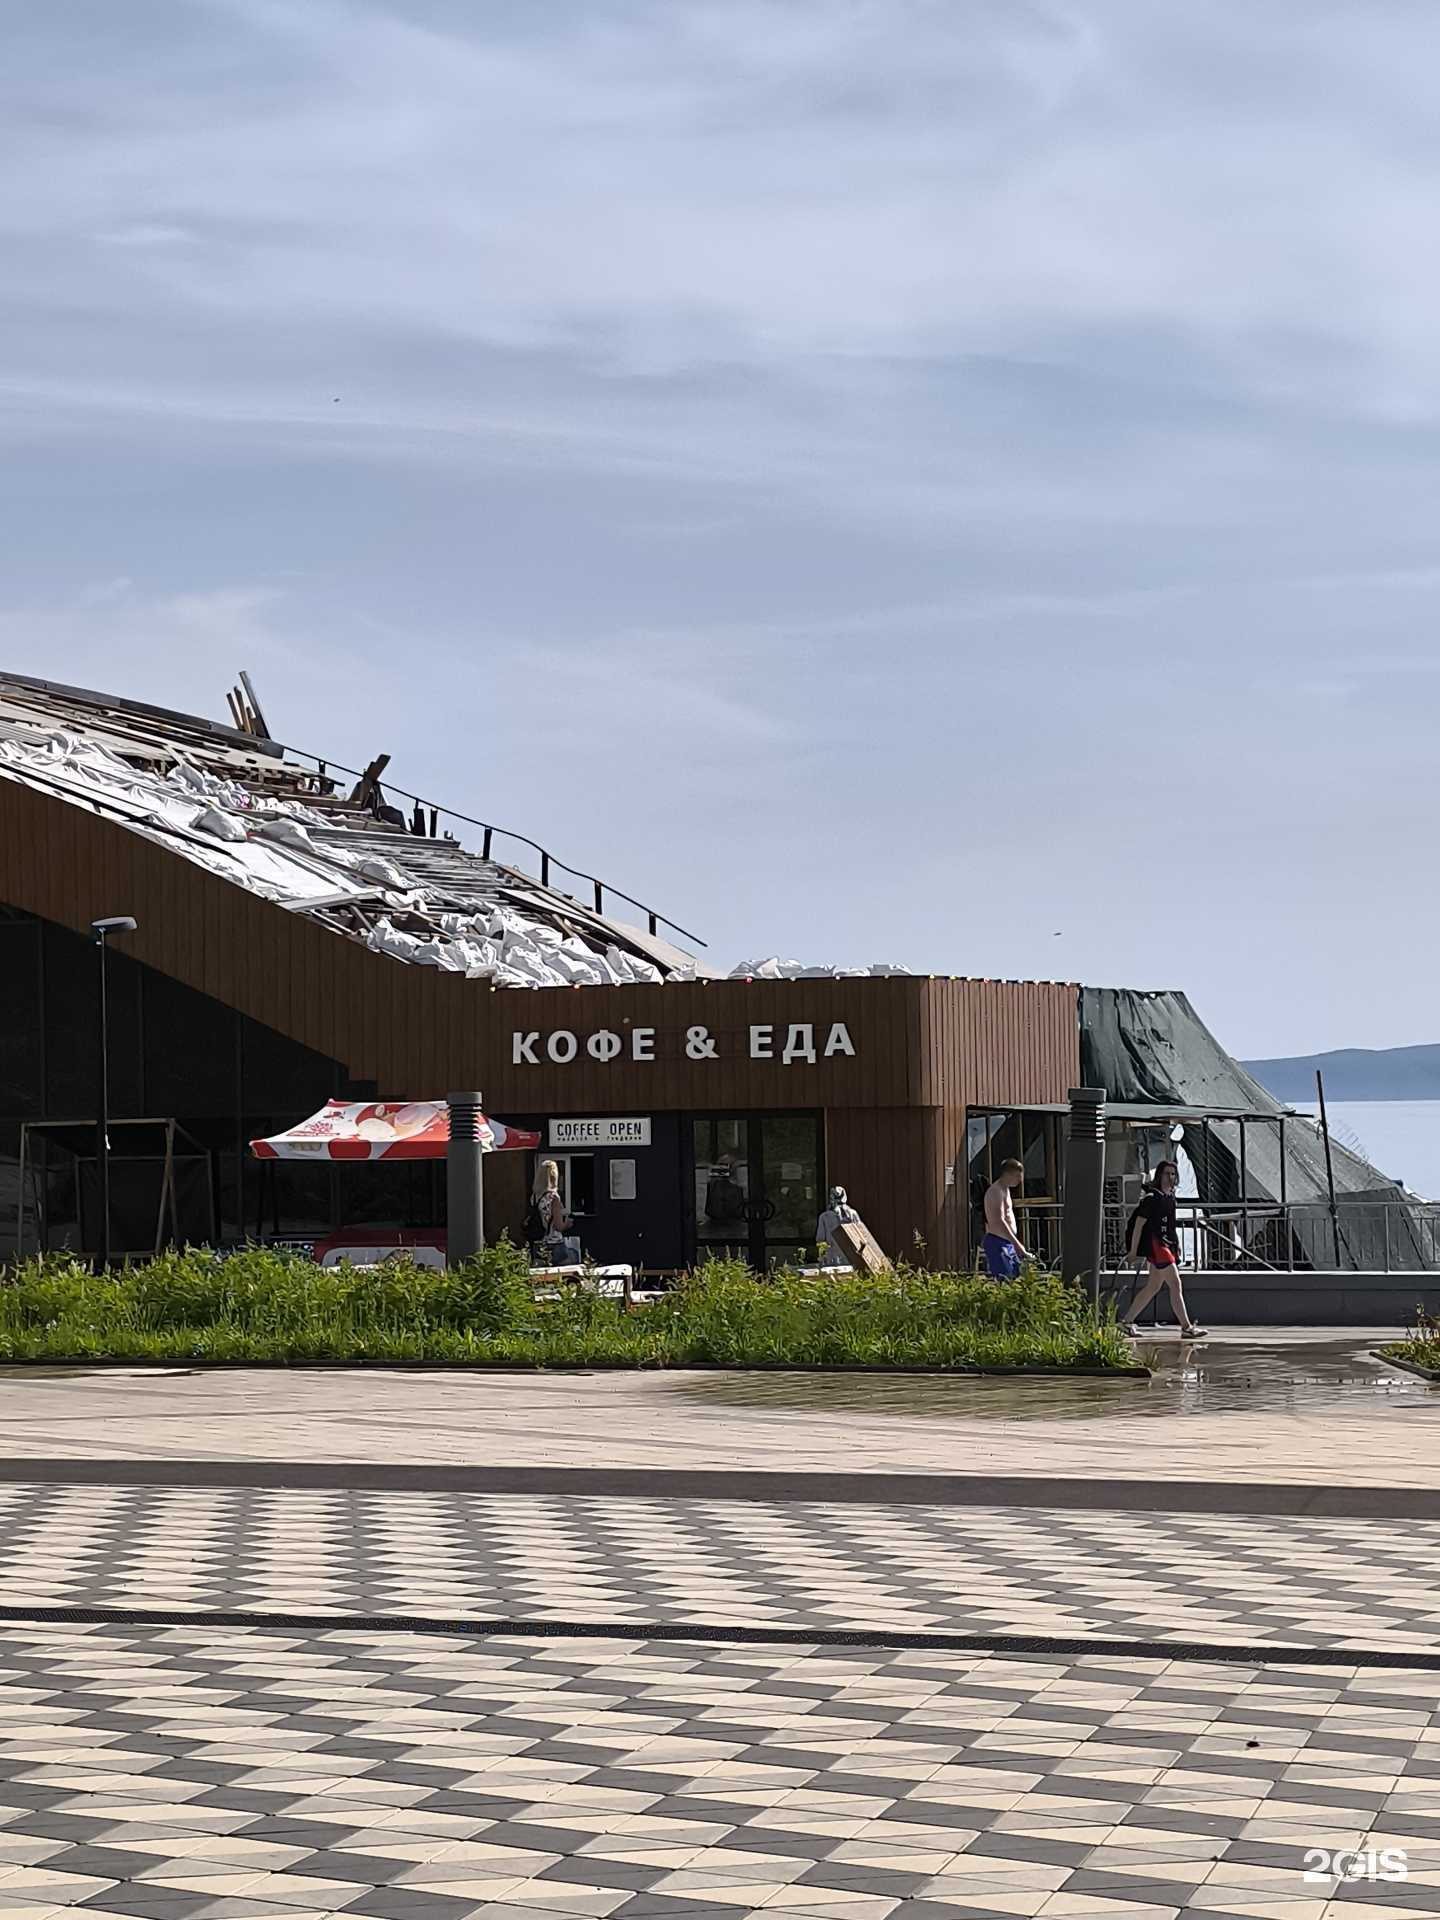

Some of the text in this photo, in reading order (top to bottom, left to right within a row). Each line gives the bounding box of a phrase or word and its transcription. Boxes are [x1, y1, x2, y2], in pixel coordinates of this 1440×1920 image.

[512, 1022, 856, 1065] КОФЕ & ЕДА
[557, 1122, 642, 1136] COFFEE OPEN
